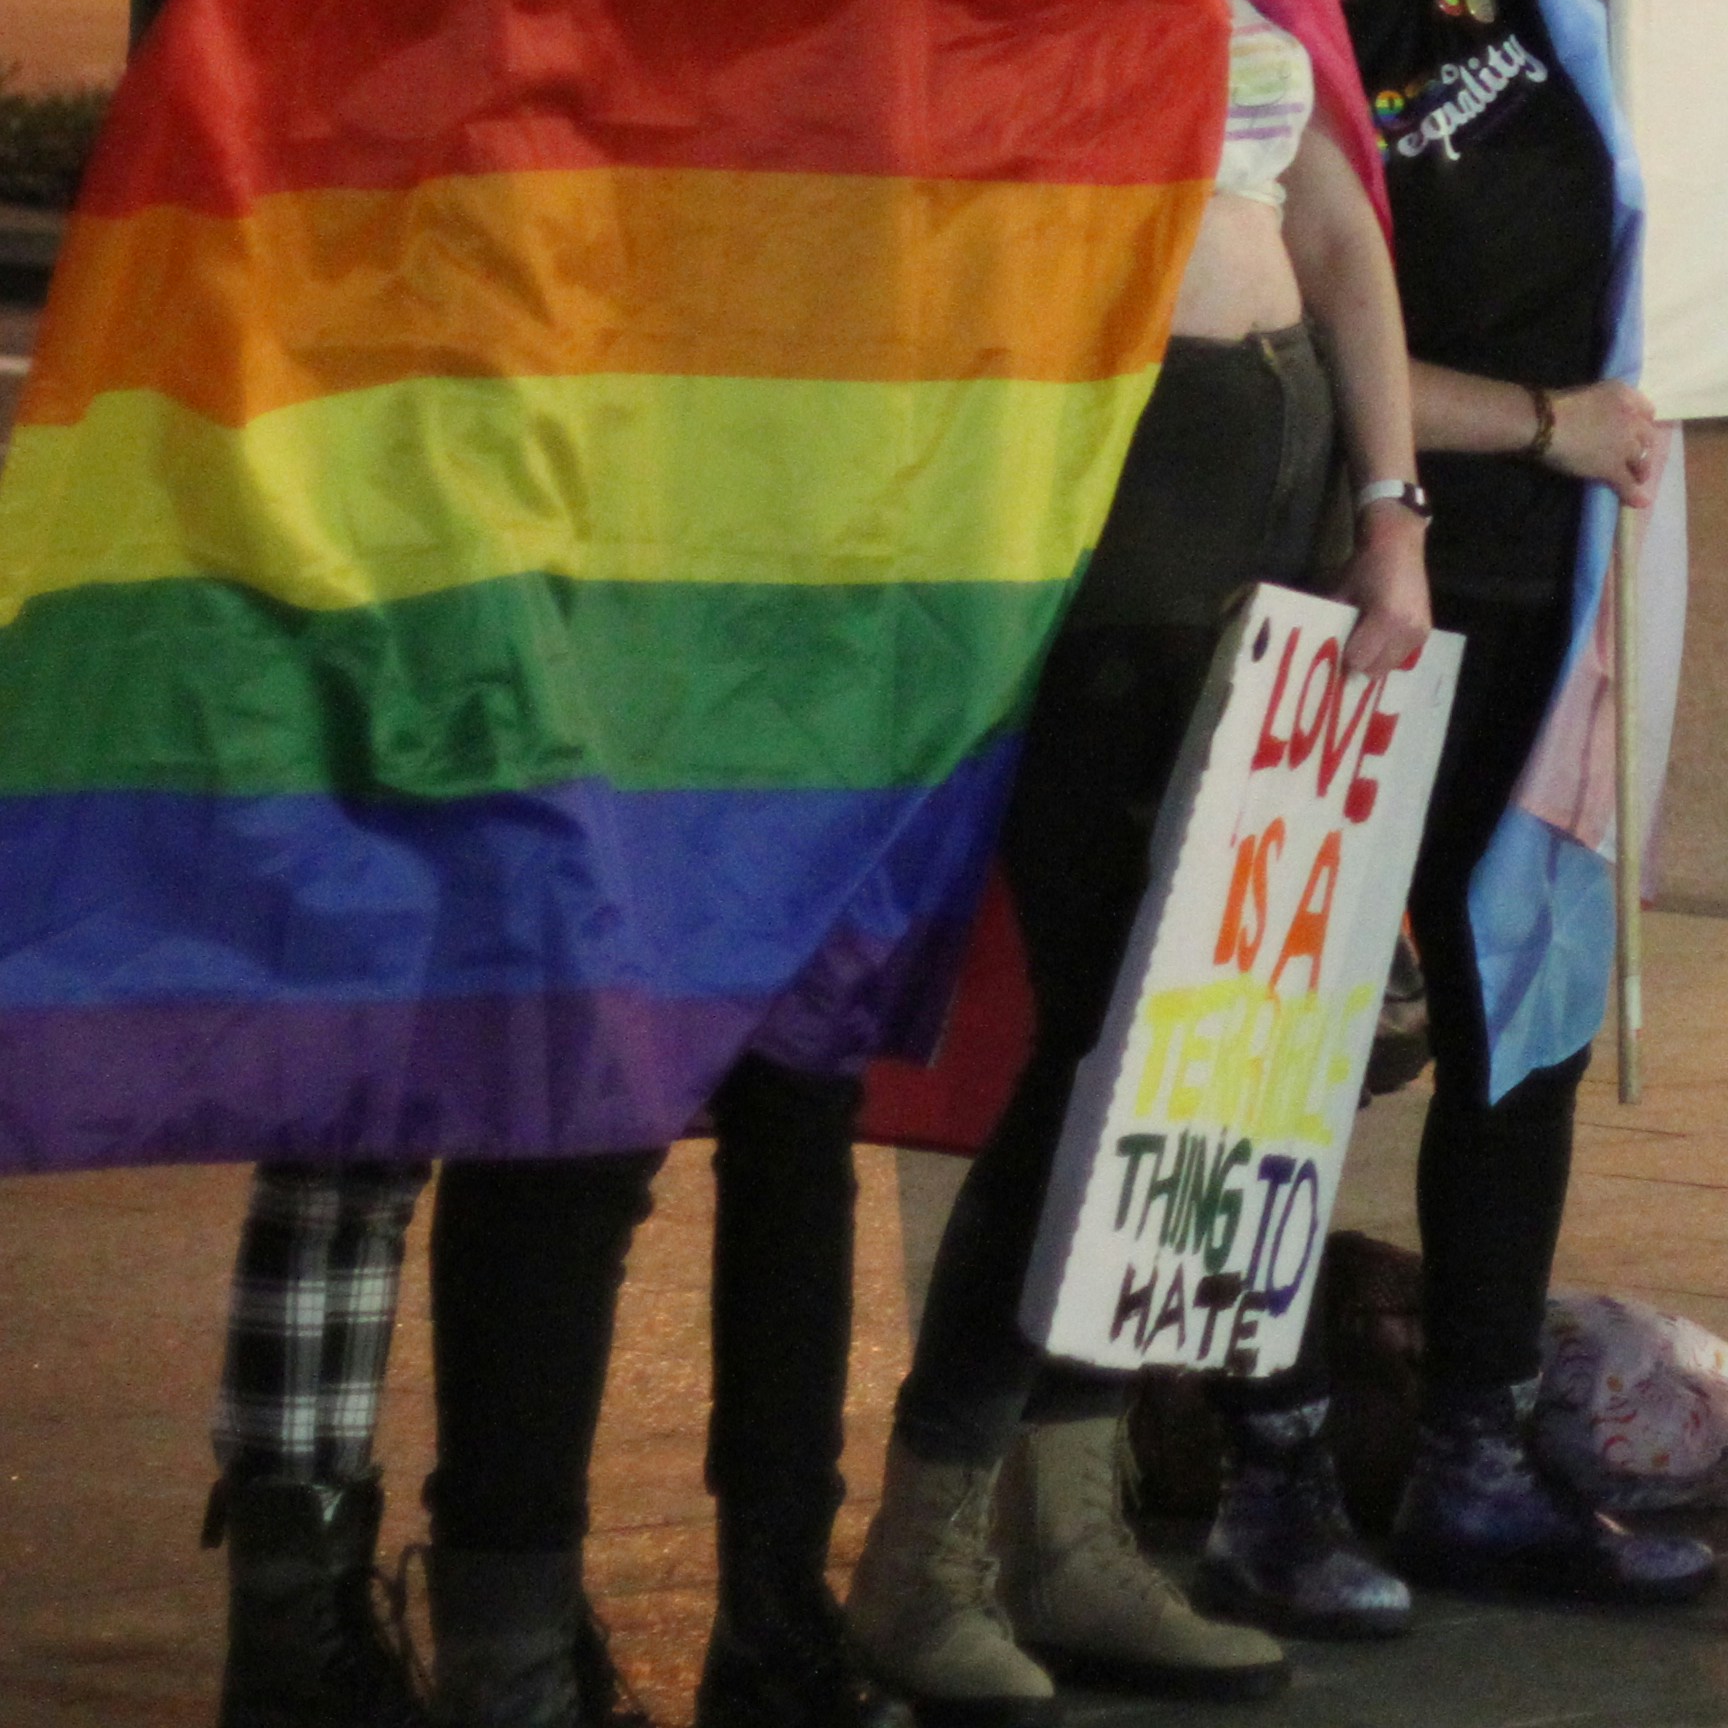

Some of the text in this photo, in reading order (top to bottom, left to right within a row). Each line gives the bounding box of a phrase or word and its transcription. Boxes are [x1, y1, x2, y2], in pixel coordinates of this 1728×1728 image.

[1212, 816, 1343, 1012] IS A
[1109, 1262, 1270, 1376] HATE
[1115, 1126, 1319, 1319] THING TO
